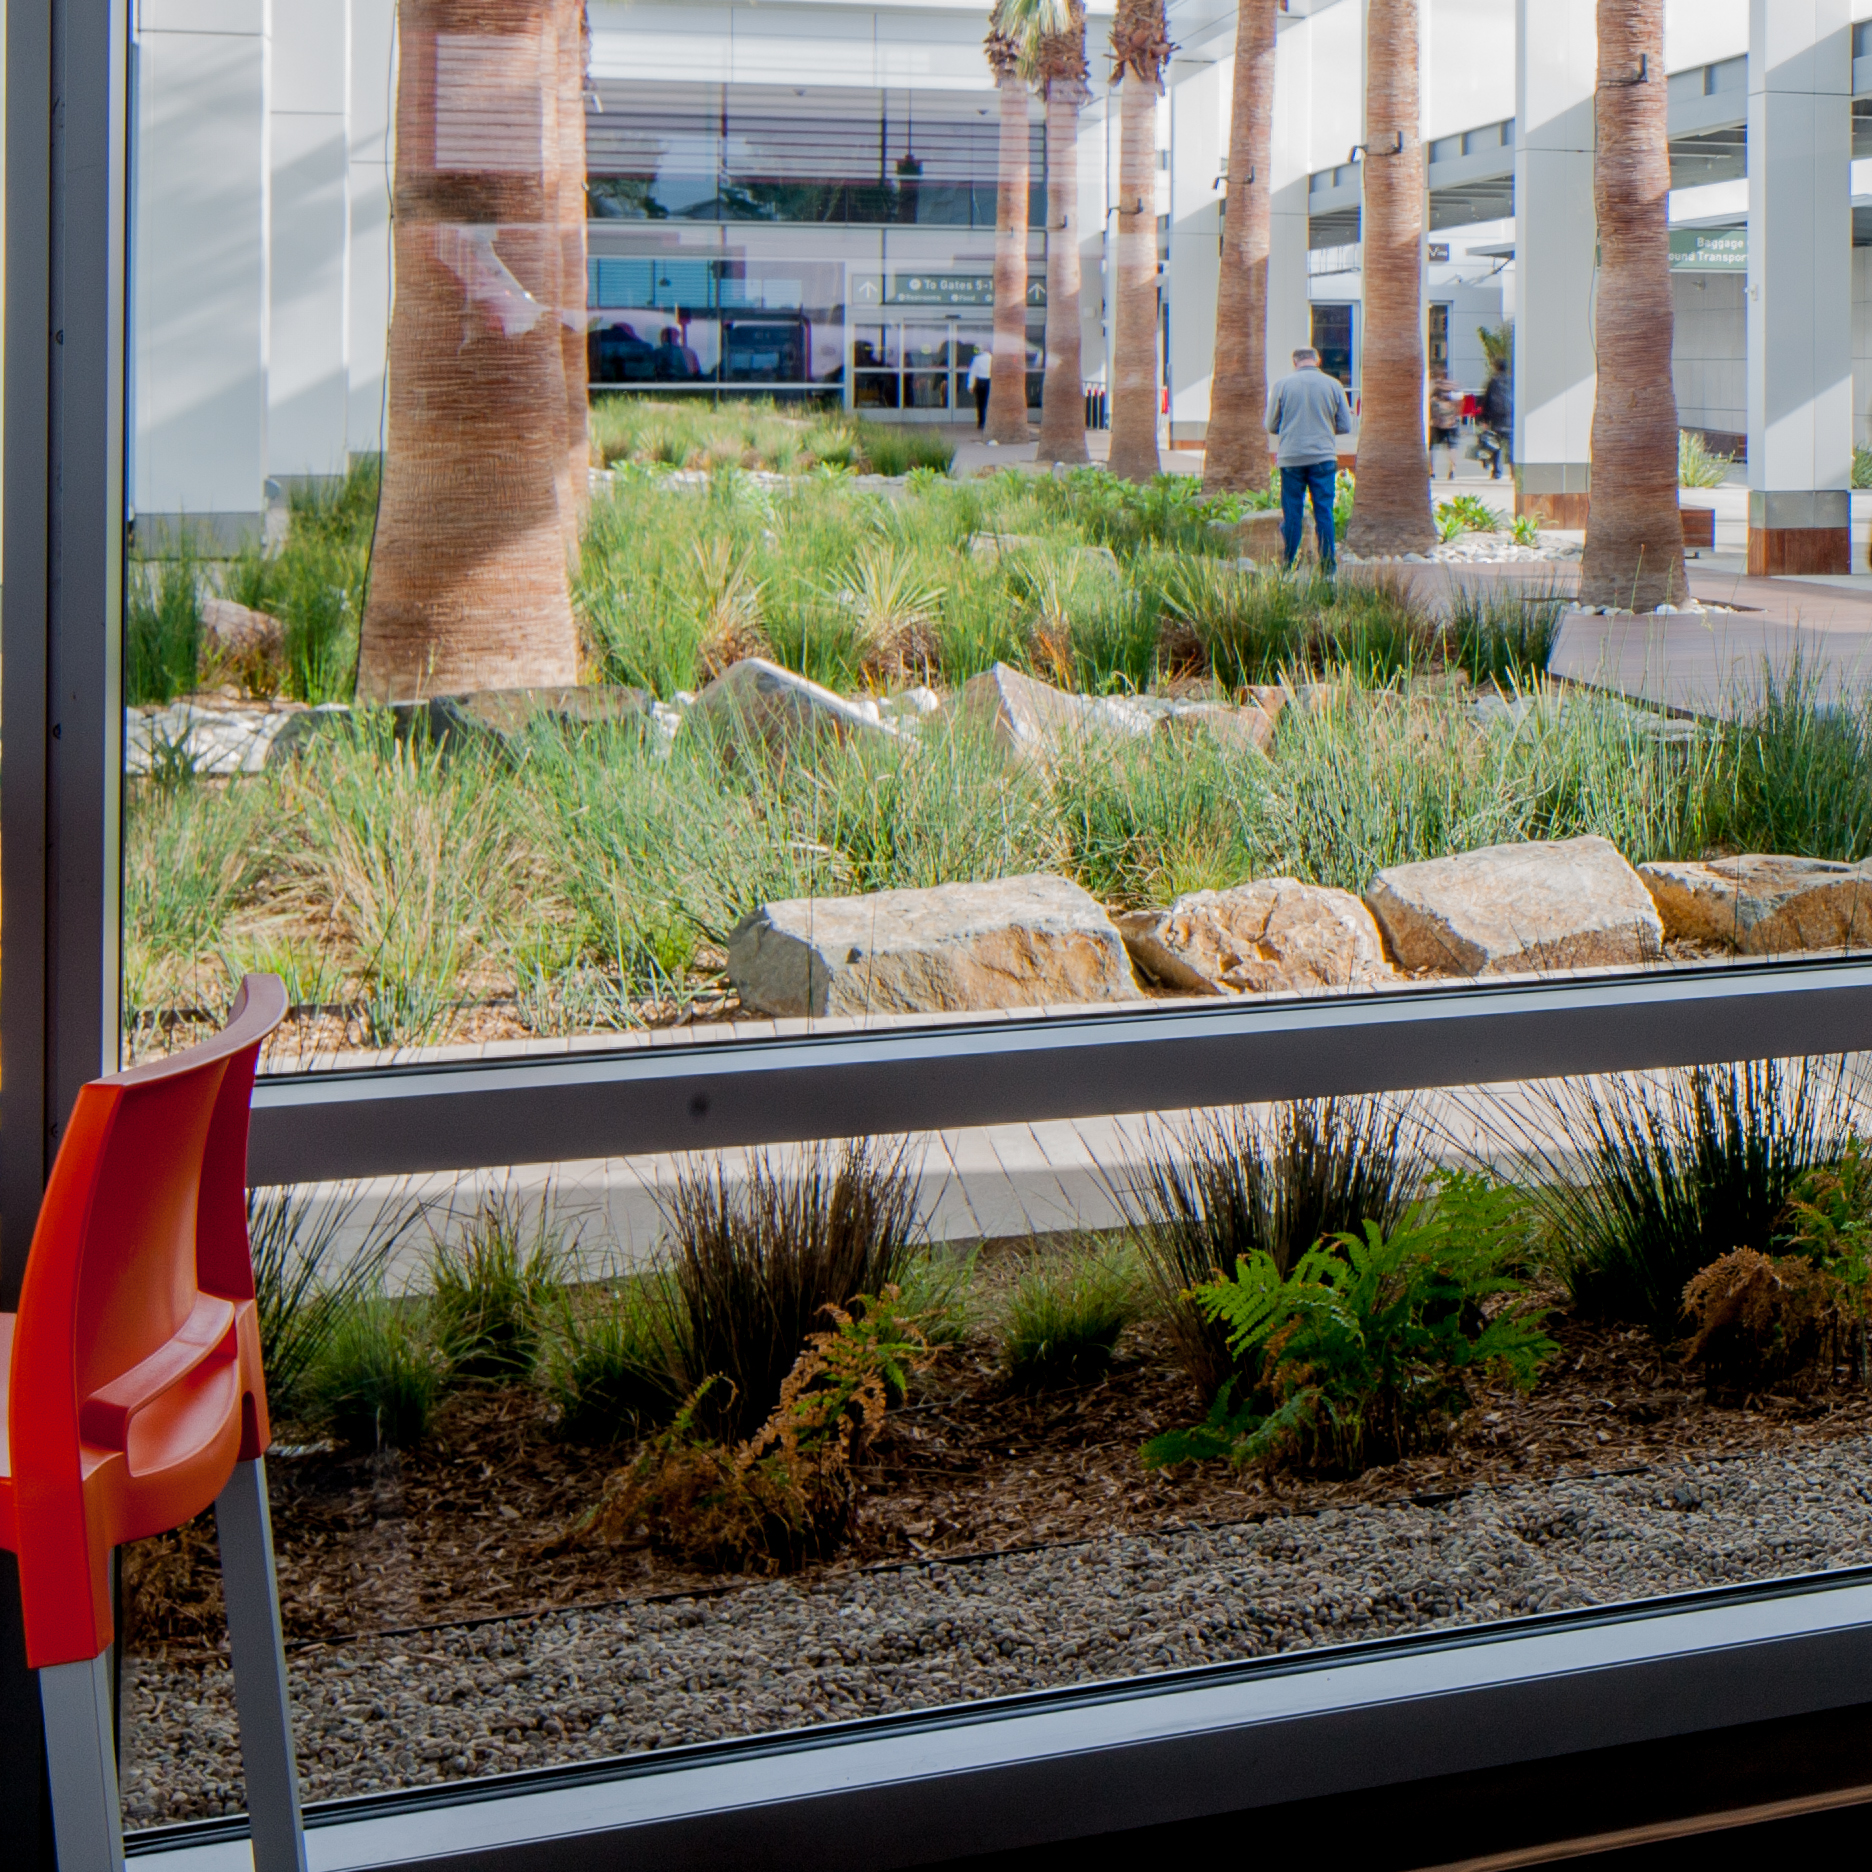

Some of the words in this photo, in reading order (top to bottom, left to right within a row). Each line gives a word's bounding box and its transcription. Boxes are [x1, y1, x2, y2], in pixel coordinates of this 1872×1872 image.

[1696, 236, 1745, 250] Baggage
[1668, 251, 1696, 262] ound
[1697, 251, 1748, 264] Transpor
[923, 279, 937, 290] To
[940, 279, 973, 290] Gates
[975, 279, 993, 291] 5-1
